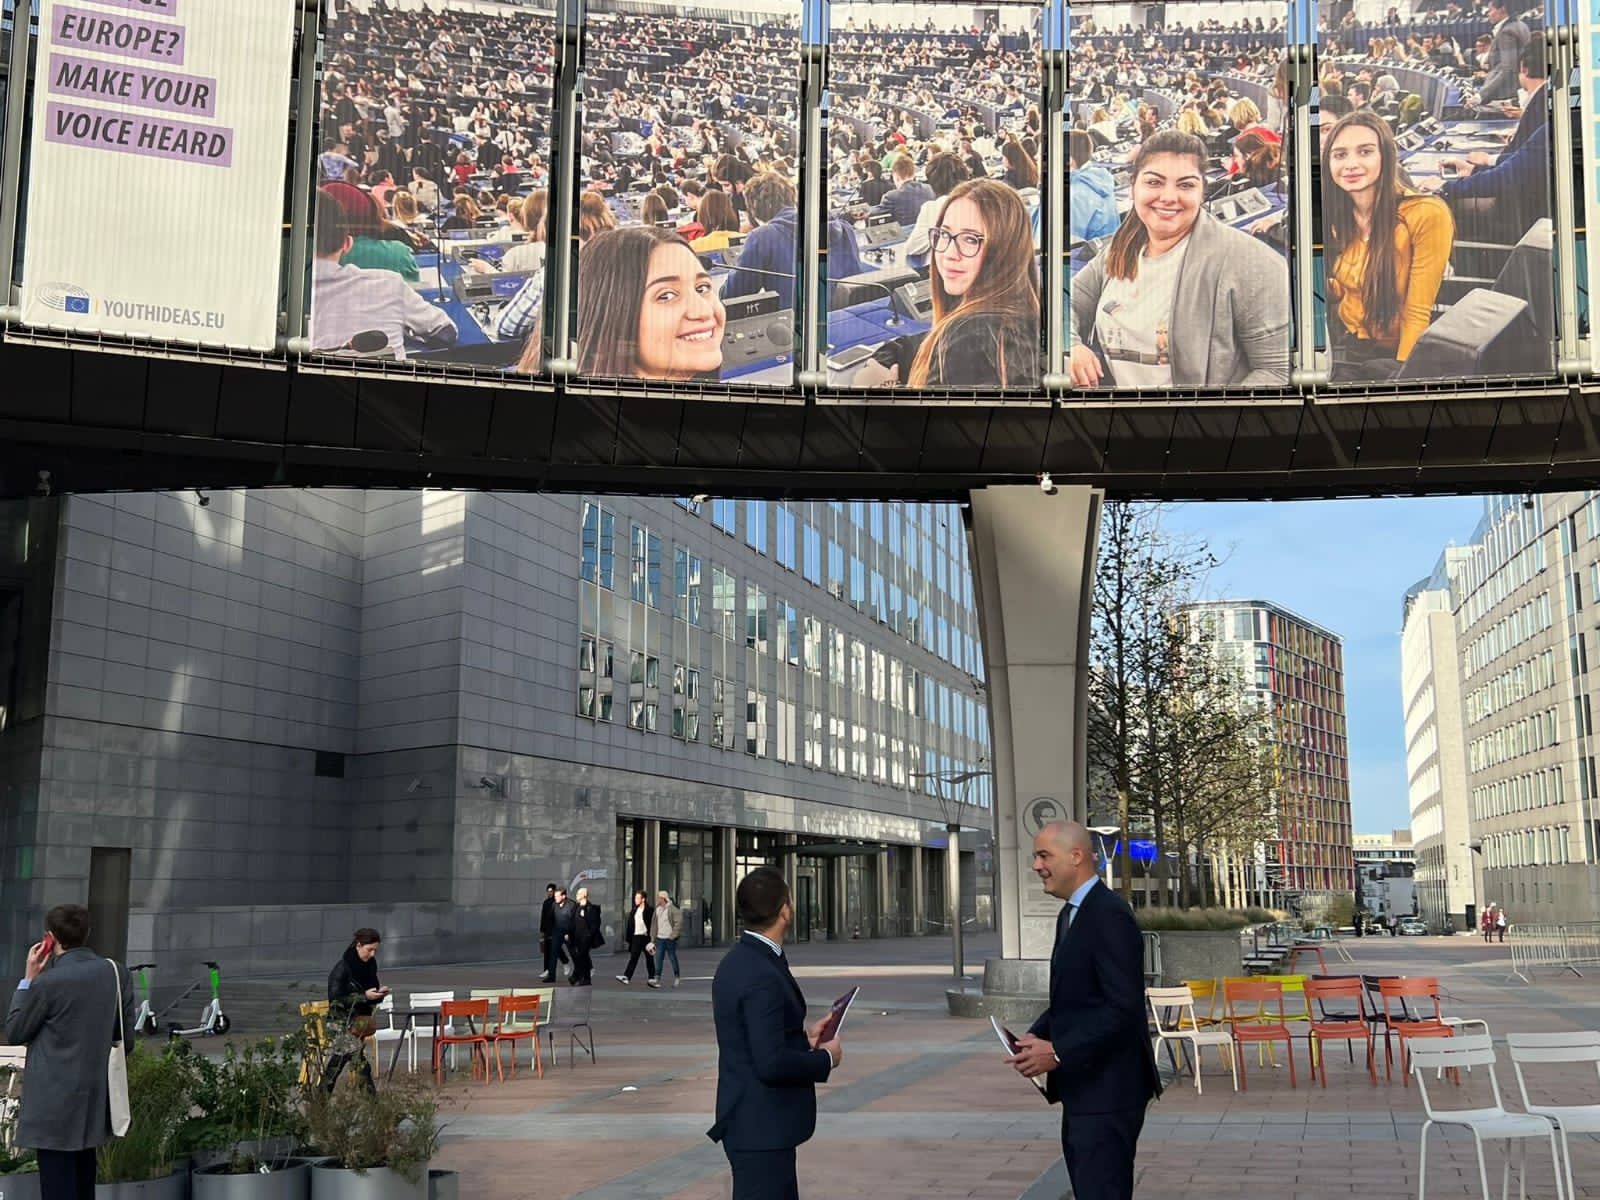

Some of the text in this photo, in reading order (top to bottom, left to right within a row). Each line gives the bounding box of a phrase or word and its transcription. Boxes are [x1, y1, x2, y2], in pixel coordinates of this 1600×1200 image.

[59, 14, 180, 56] EUROPE?
[55, 62, 210, 109] MAKE YOUR
[56, 110, 226, 158] VOICE HEARD
[103, 300, 225, 329] YOUTHIDEAS.EU
